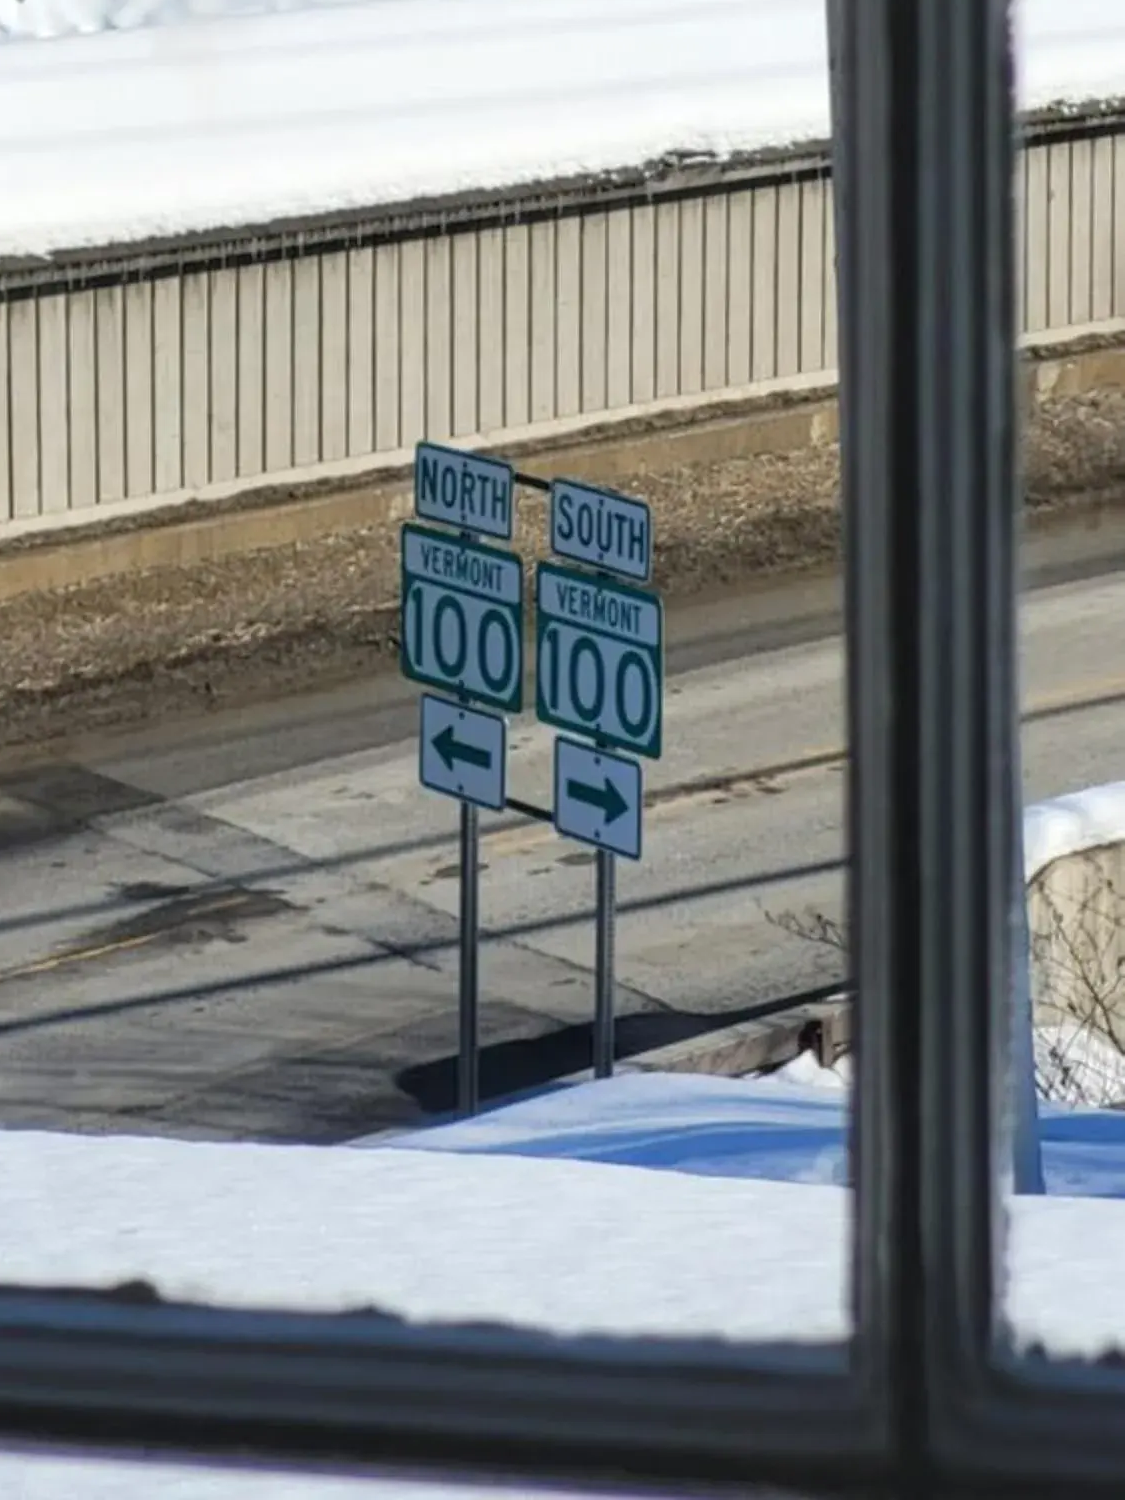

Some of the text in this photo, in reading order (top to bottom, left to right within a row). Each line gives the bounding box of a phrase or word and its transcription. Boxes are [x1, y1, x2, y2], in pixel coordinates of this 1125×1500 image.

[420, 455, 508, 523] NORTH
[557, 493, 646, 564] SOUTH
[420, 543, 505, 592] VERMONT
[411, 585, 514, 693] 100
[555, 581, 643, 635] VERMONT
[546, 627, 652, 739] 100
